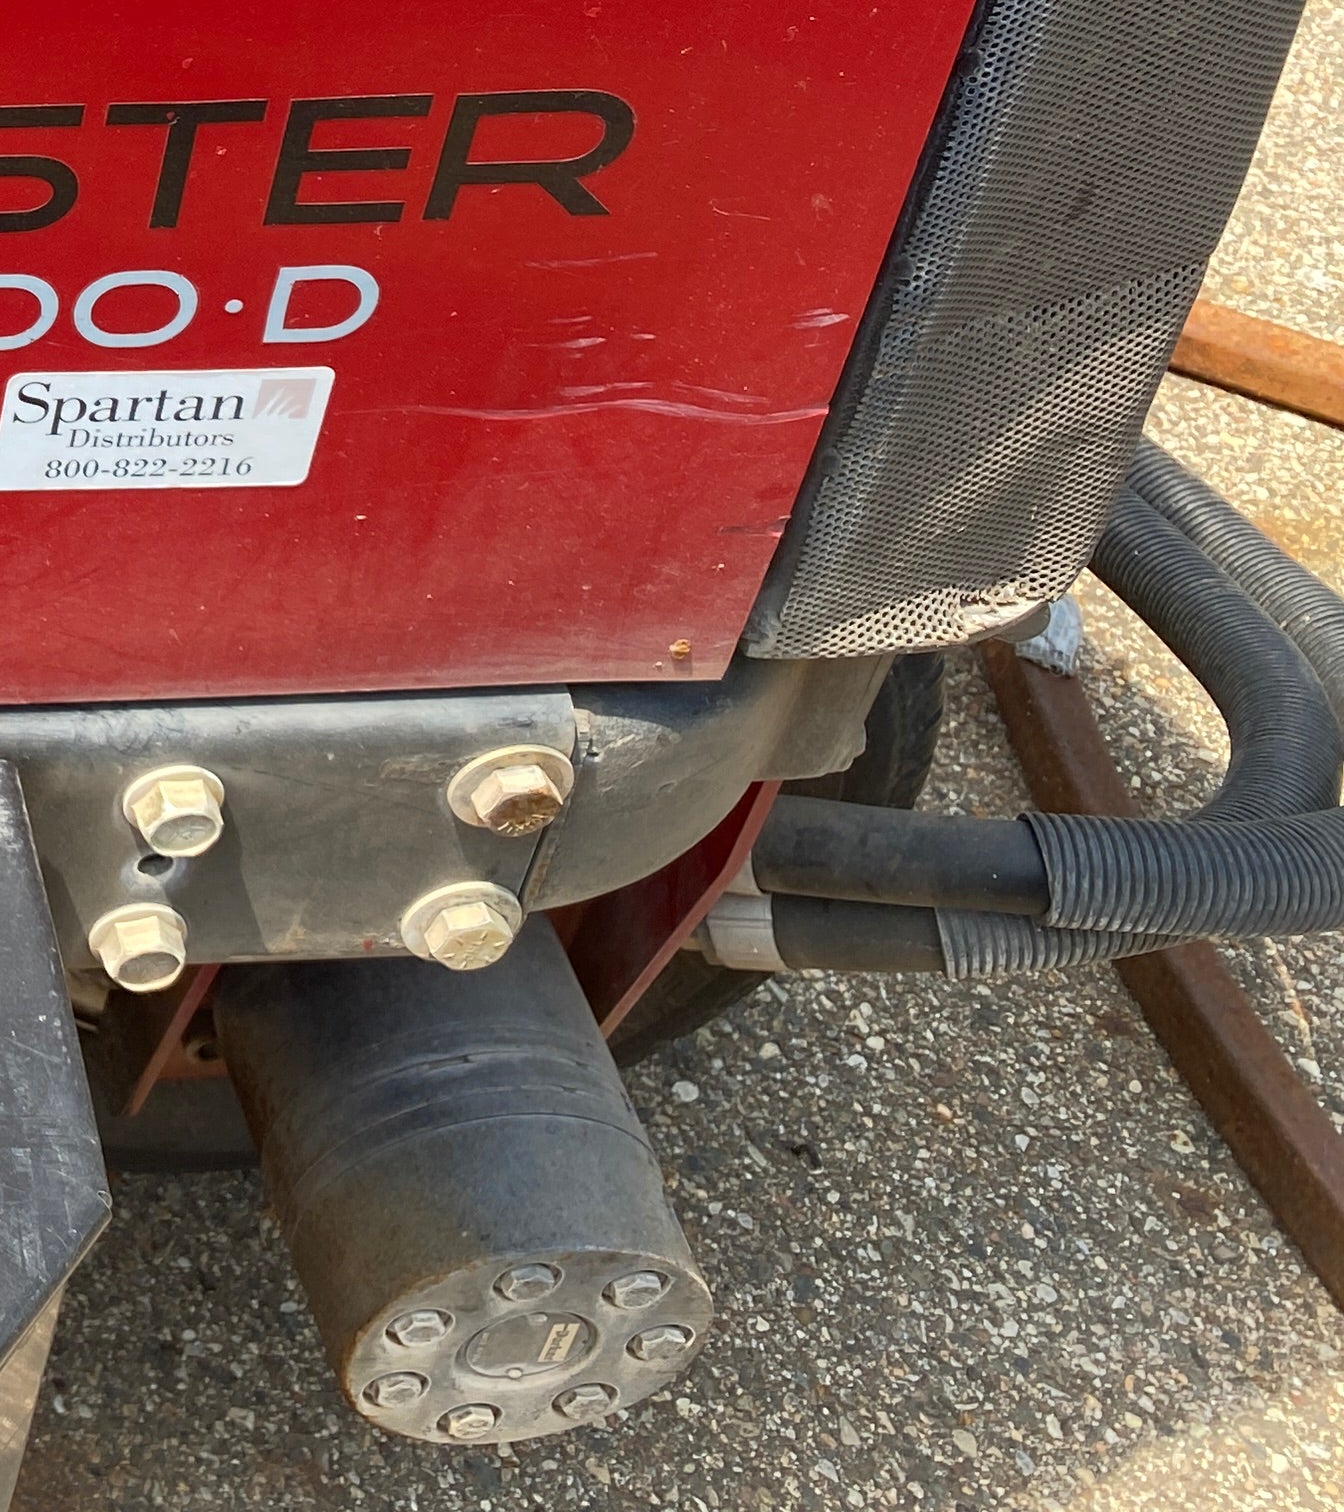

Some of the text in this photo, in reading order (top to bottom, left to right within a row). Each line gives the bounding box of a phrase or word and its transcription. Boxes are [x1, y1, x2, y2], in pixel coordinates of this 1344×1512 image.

[12, 381, 246, 436] Spartan
[66, 427, 235, 449] Distributors
[44, 455, 255, 479] 800-822-2216
